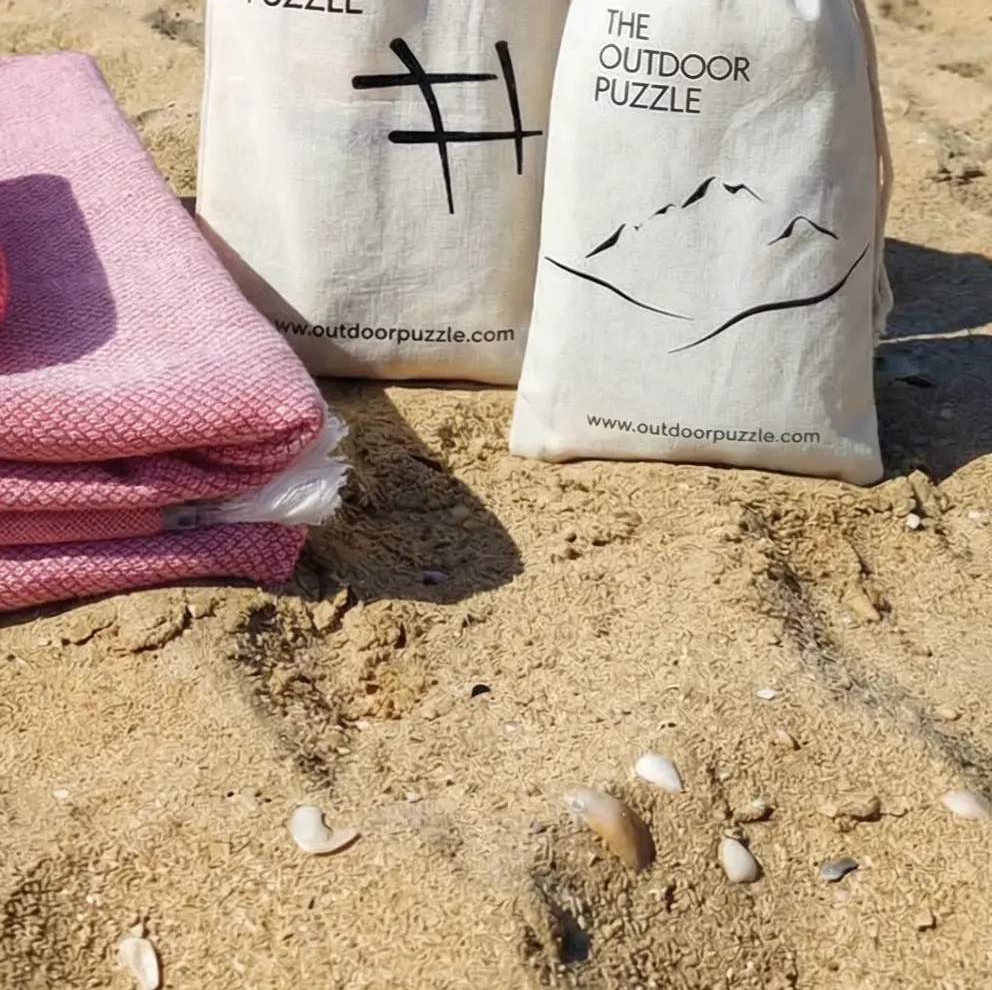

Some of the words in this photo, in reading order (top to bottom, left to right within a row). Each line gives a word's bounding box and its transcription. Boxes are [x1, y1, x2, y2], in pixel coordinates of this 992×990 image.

[607, 9, 650, 40] THE
[599, 43, 750, 82] OUTDOOR
[594, 76, 701, 114] PUZZLE
[275, 319, 515, 345] ww.outdoorpuzzle.com
[586, 413, 820, 443] www.outdoorpuzzle.com
